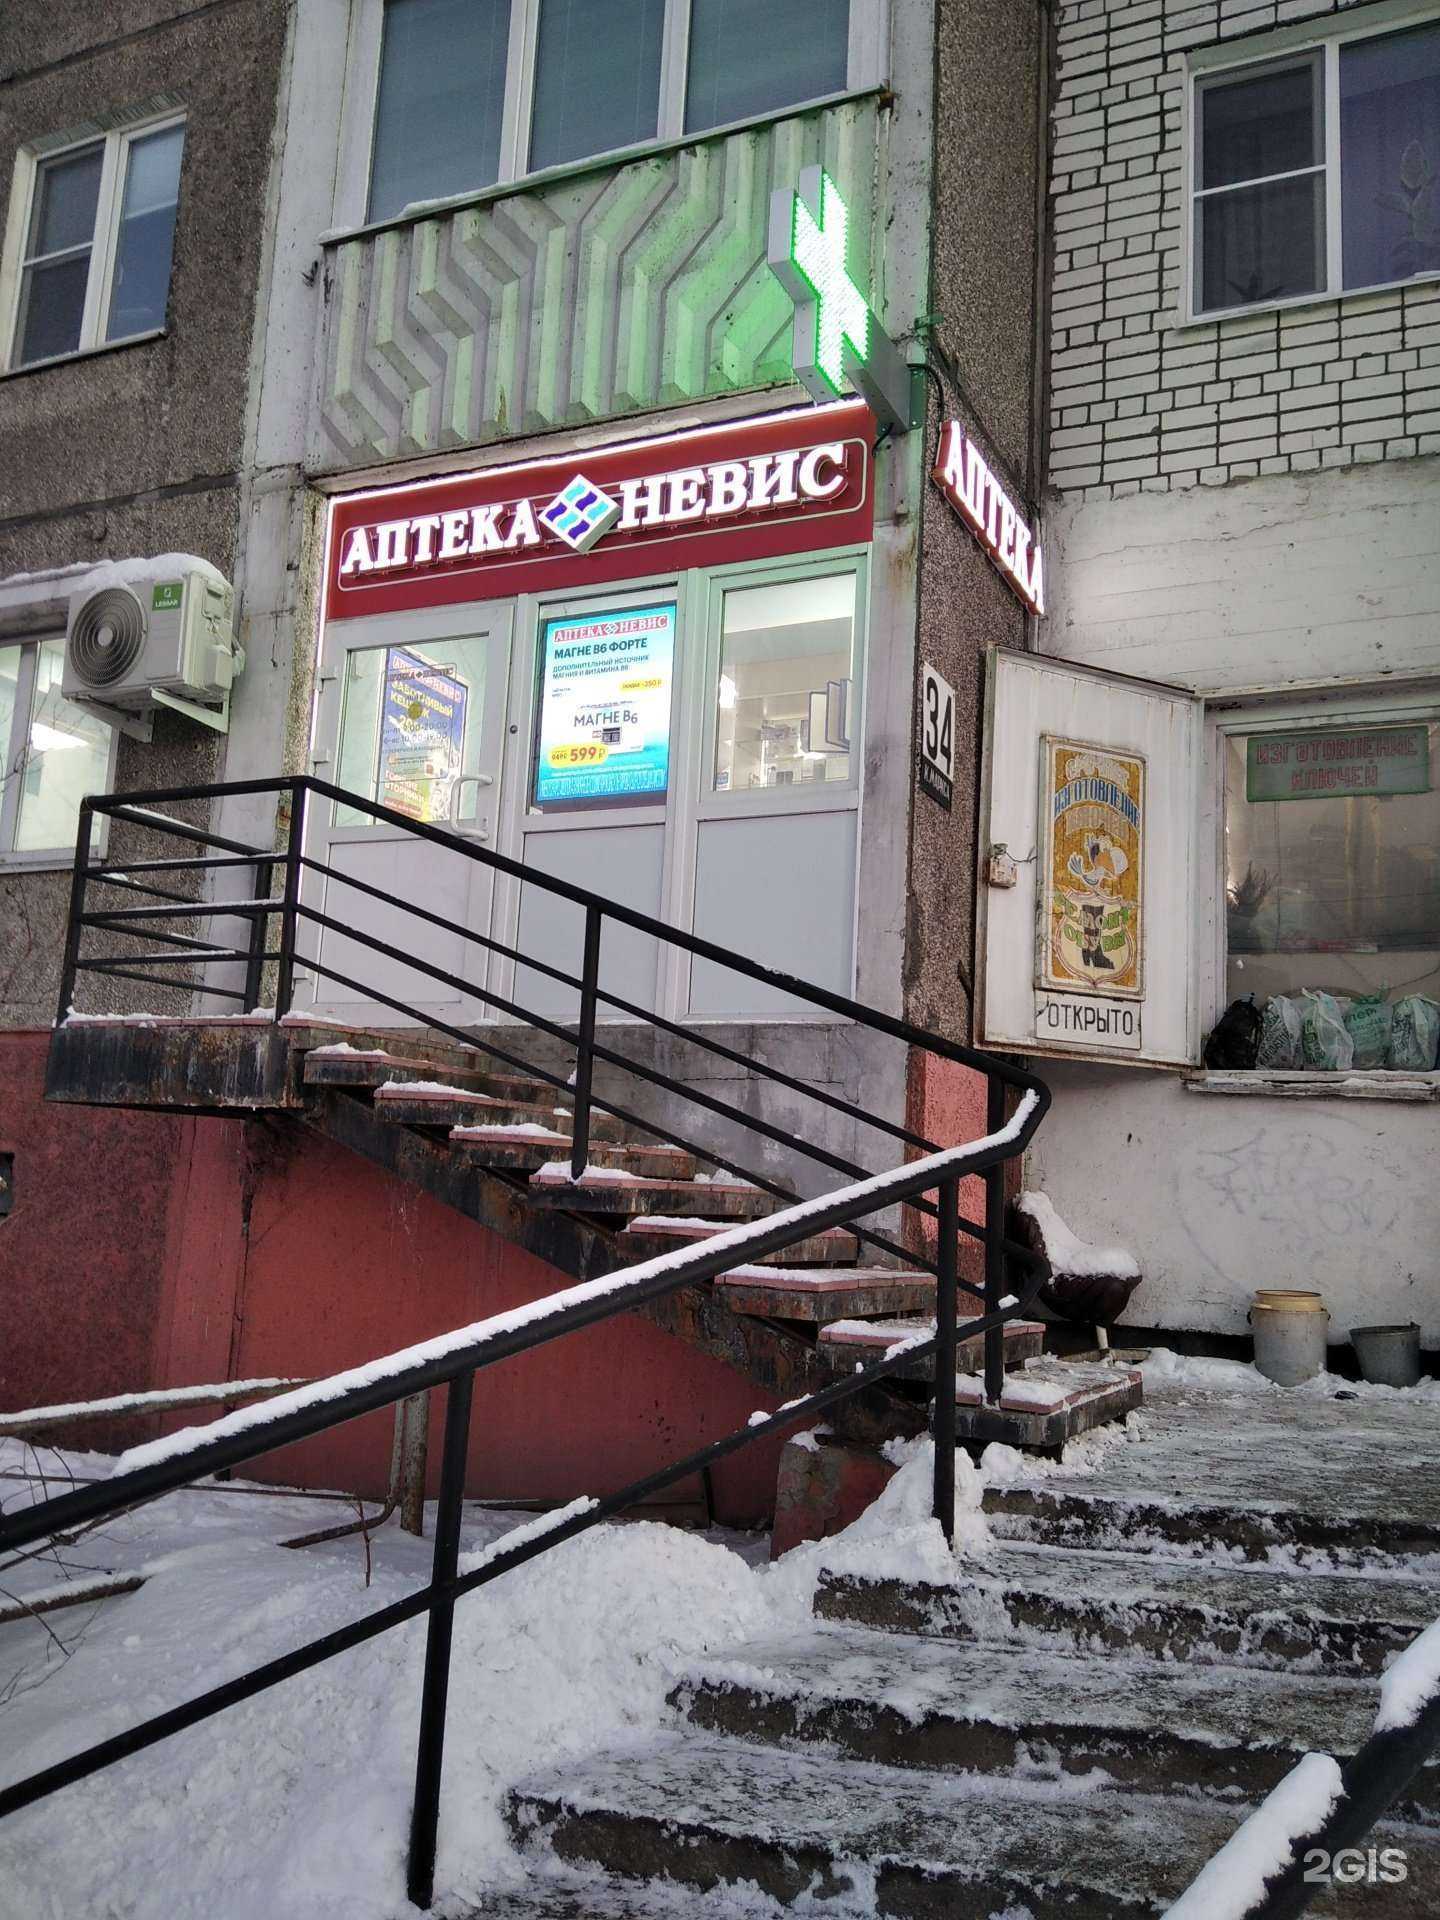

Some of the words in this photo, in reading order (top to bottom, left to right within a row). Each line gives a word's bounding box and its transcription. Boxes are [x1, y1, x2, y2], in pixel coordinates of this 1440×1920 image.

[340, 498, 542, 575] АПТЕКА
[617, 443, 849, 530] НЕВИС
[943, 419, 1045, 615] АПТЕКА
[555, 625, 603, 641] АПТЕКА
[619, 616, 668, 633] НЕВИС
[552, 659, 614, 673] ДОПОЛНИТЕЛЬНЫЙ
[614, 655, 649, 664] ИСТОЧНИК
[554, 645, 592, 660] МАГНЕ
[593, 642, 607, 655] В6
[608, 638, 648, 652] ФОРТЕ
[574, 711, 620, 728] МАГНЕ
[622, 709, 639, 724] В6
[927, 676, 952, 775] 34
[570, 747, 597, 762] 599
[1256, 735, 1417, 765] ИЗГОТОВЛЕНИЕ
[1291, 760, 1378, 791] КЛЮЧЕЙ
[1054, 778, 1139, 829] ИЗГОТОВЛЕНИЕ
[1047, 1003, 1133, 1036] ОТКРЫТО
